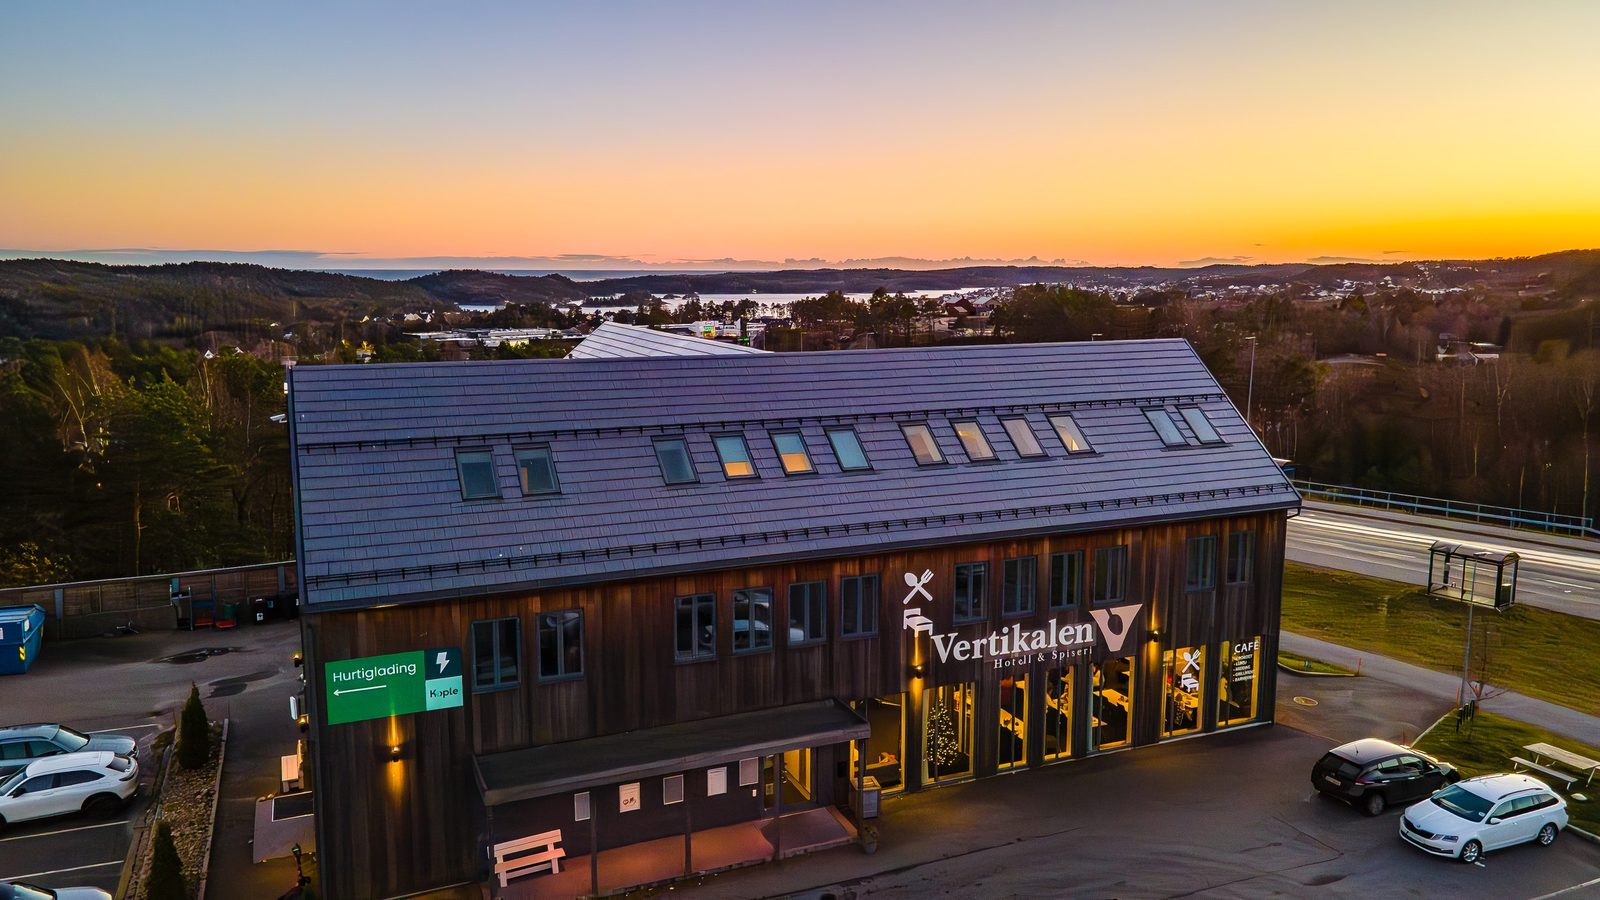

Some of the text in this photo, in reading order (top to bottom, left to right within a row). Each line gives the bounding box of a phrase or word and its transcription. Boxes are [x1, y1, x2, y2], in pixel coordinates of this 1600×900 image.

[931, 618, 1094, 664] Vertikalen
[994, 646, 1093, 669] Hotell & Spiseri
[332, 663, 417, 683] Hurtiglading
[429, 687, 459, 699] Kople
